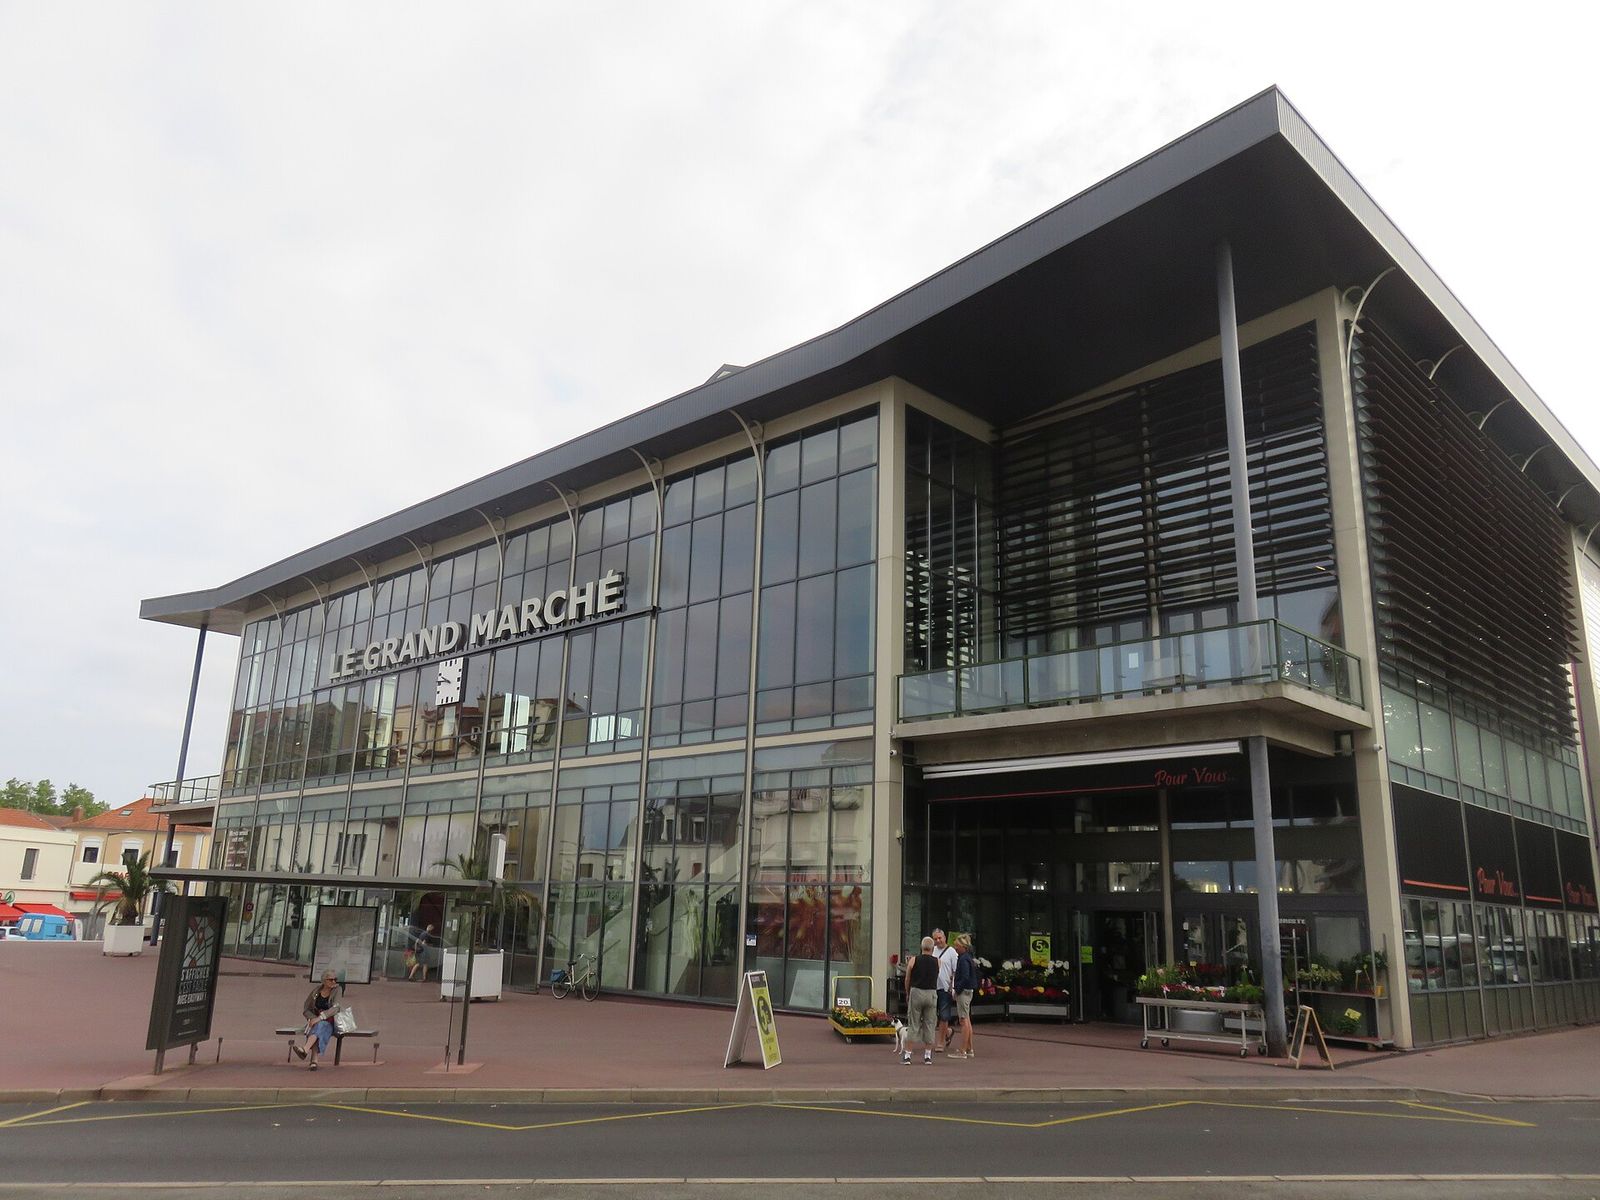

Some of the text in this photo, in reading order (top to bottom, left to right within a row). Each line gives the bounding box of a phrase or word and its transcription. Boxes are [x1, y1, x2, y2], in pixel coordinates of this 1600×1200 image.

[329, 569, 624, 680] LE GRAND MARCHÉ
[1154, 769, 1188, 786] Pour
[1477, 867, 1496, 894] Pour
